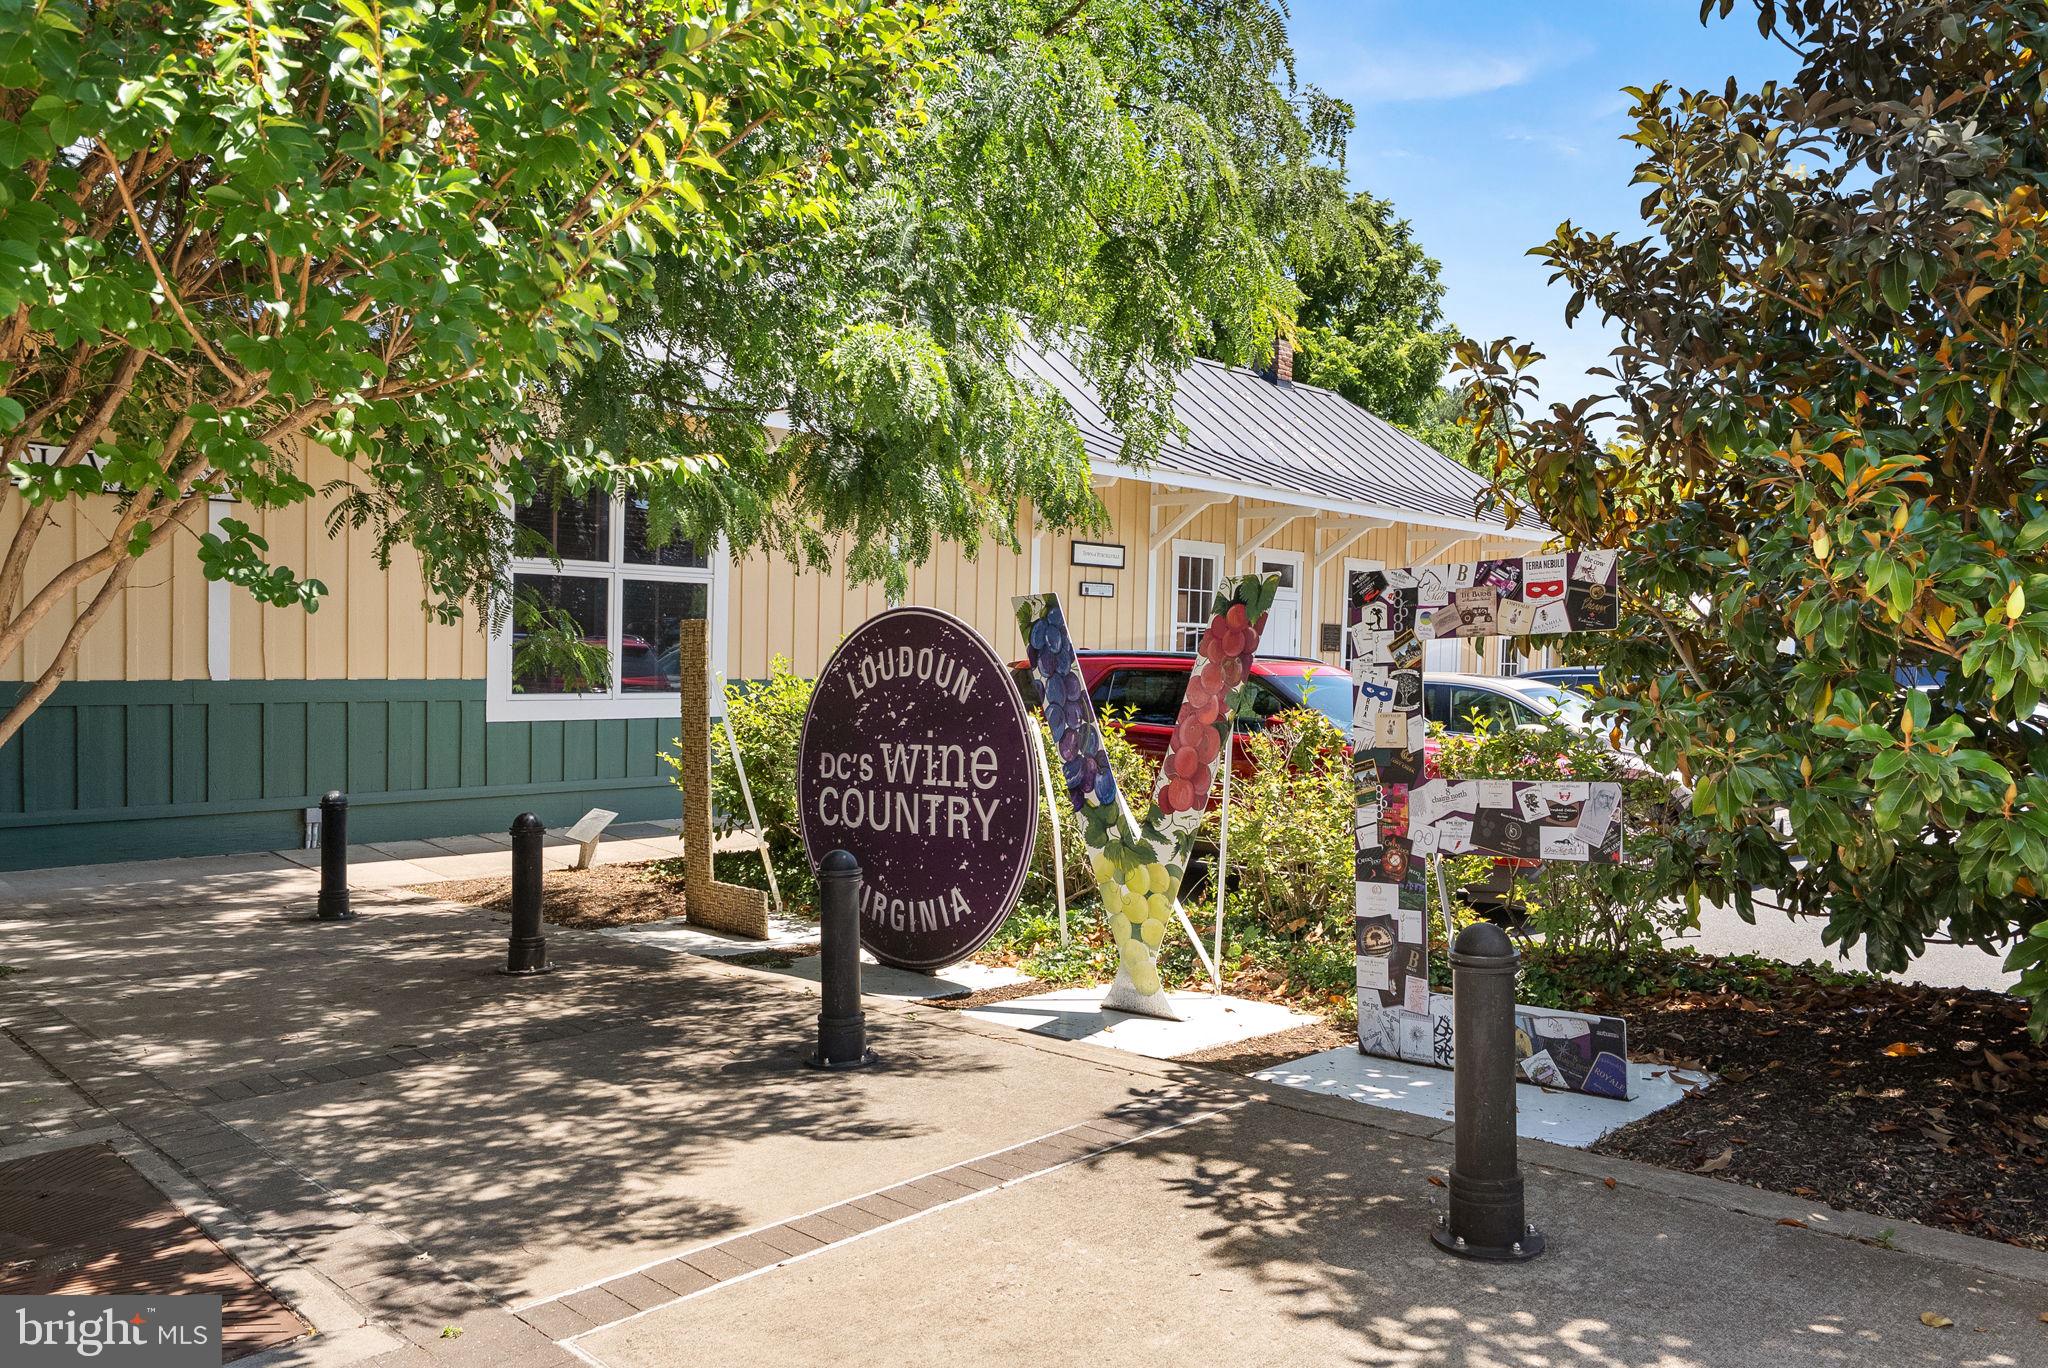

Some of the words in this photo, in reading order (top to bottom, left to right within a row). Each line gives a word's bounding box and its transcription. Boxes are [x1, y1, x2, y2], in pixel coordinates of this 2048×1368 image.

[1525, 561, 1543, 571] TERRA
[1543, 559, 1565, 569] NEBULO
[846, 646, 976, 704] LOUDOUN
[819, 751, 874, 781] DC'S
[1431, 793, 1450, 804] chains
[1450, 789, 1468, 799] north
[819, 786, 1000, 841] COUNTRY
[859, 879, 972, 933] IRGINIA
[1594, 1067, 1626, 1091] ROYALE
